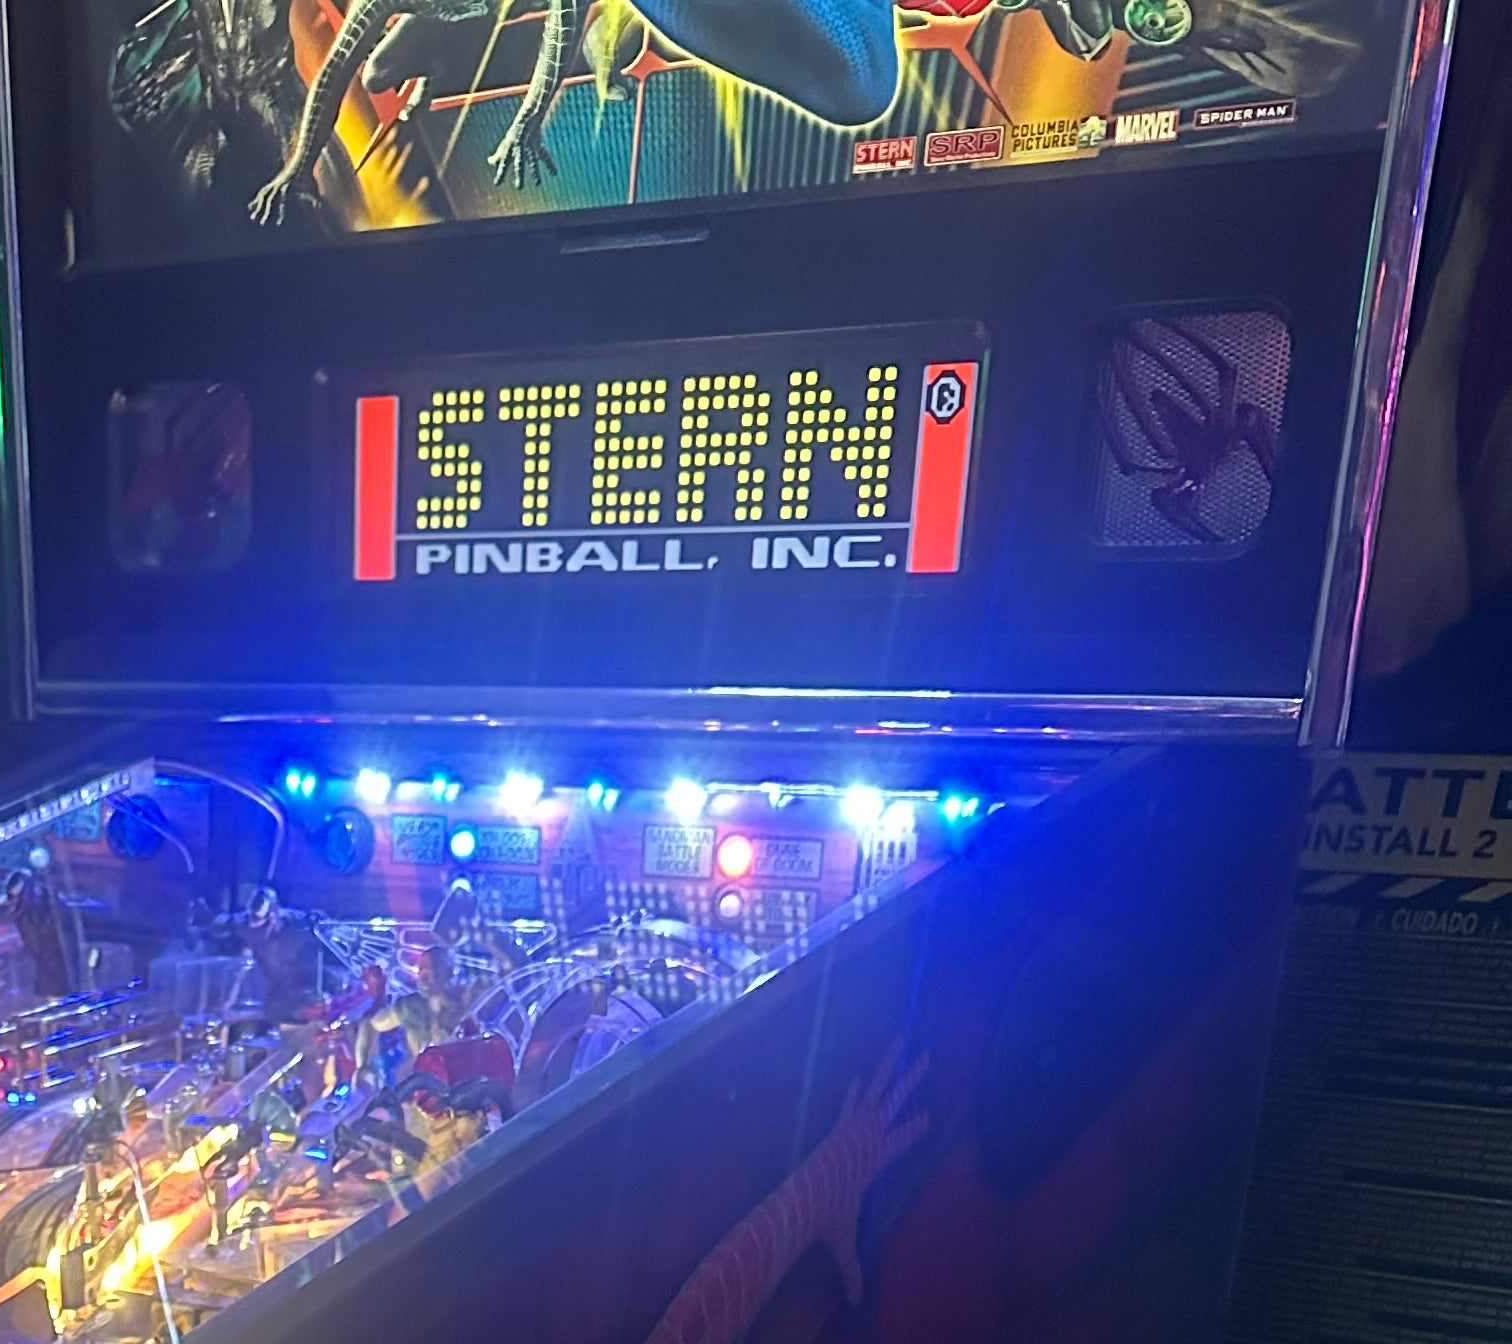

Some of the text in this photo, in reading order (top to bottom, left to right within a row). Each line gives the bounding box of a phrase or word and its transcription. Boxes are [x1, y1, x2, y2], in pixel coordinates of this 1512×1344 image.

[1011, 119, 1079, 139] COLUMBIA
[1013, 130, 1077, 151] PICTURES
[1114, 110, 1178, 145] MARVEL
[856, 138, 913, 163] STERN
[929, 131, 1000, 156] SRP
[416, 365, 898, 529] STERN
[751, 535, 897, 570] INC.
[1472, 829, 1497, 859] 2
[1391, 908, 1479, 935] CUIDADO
